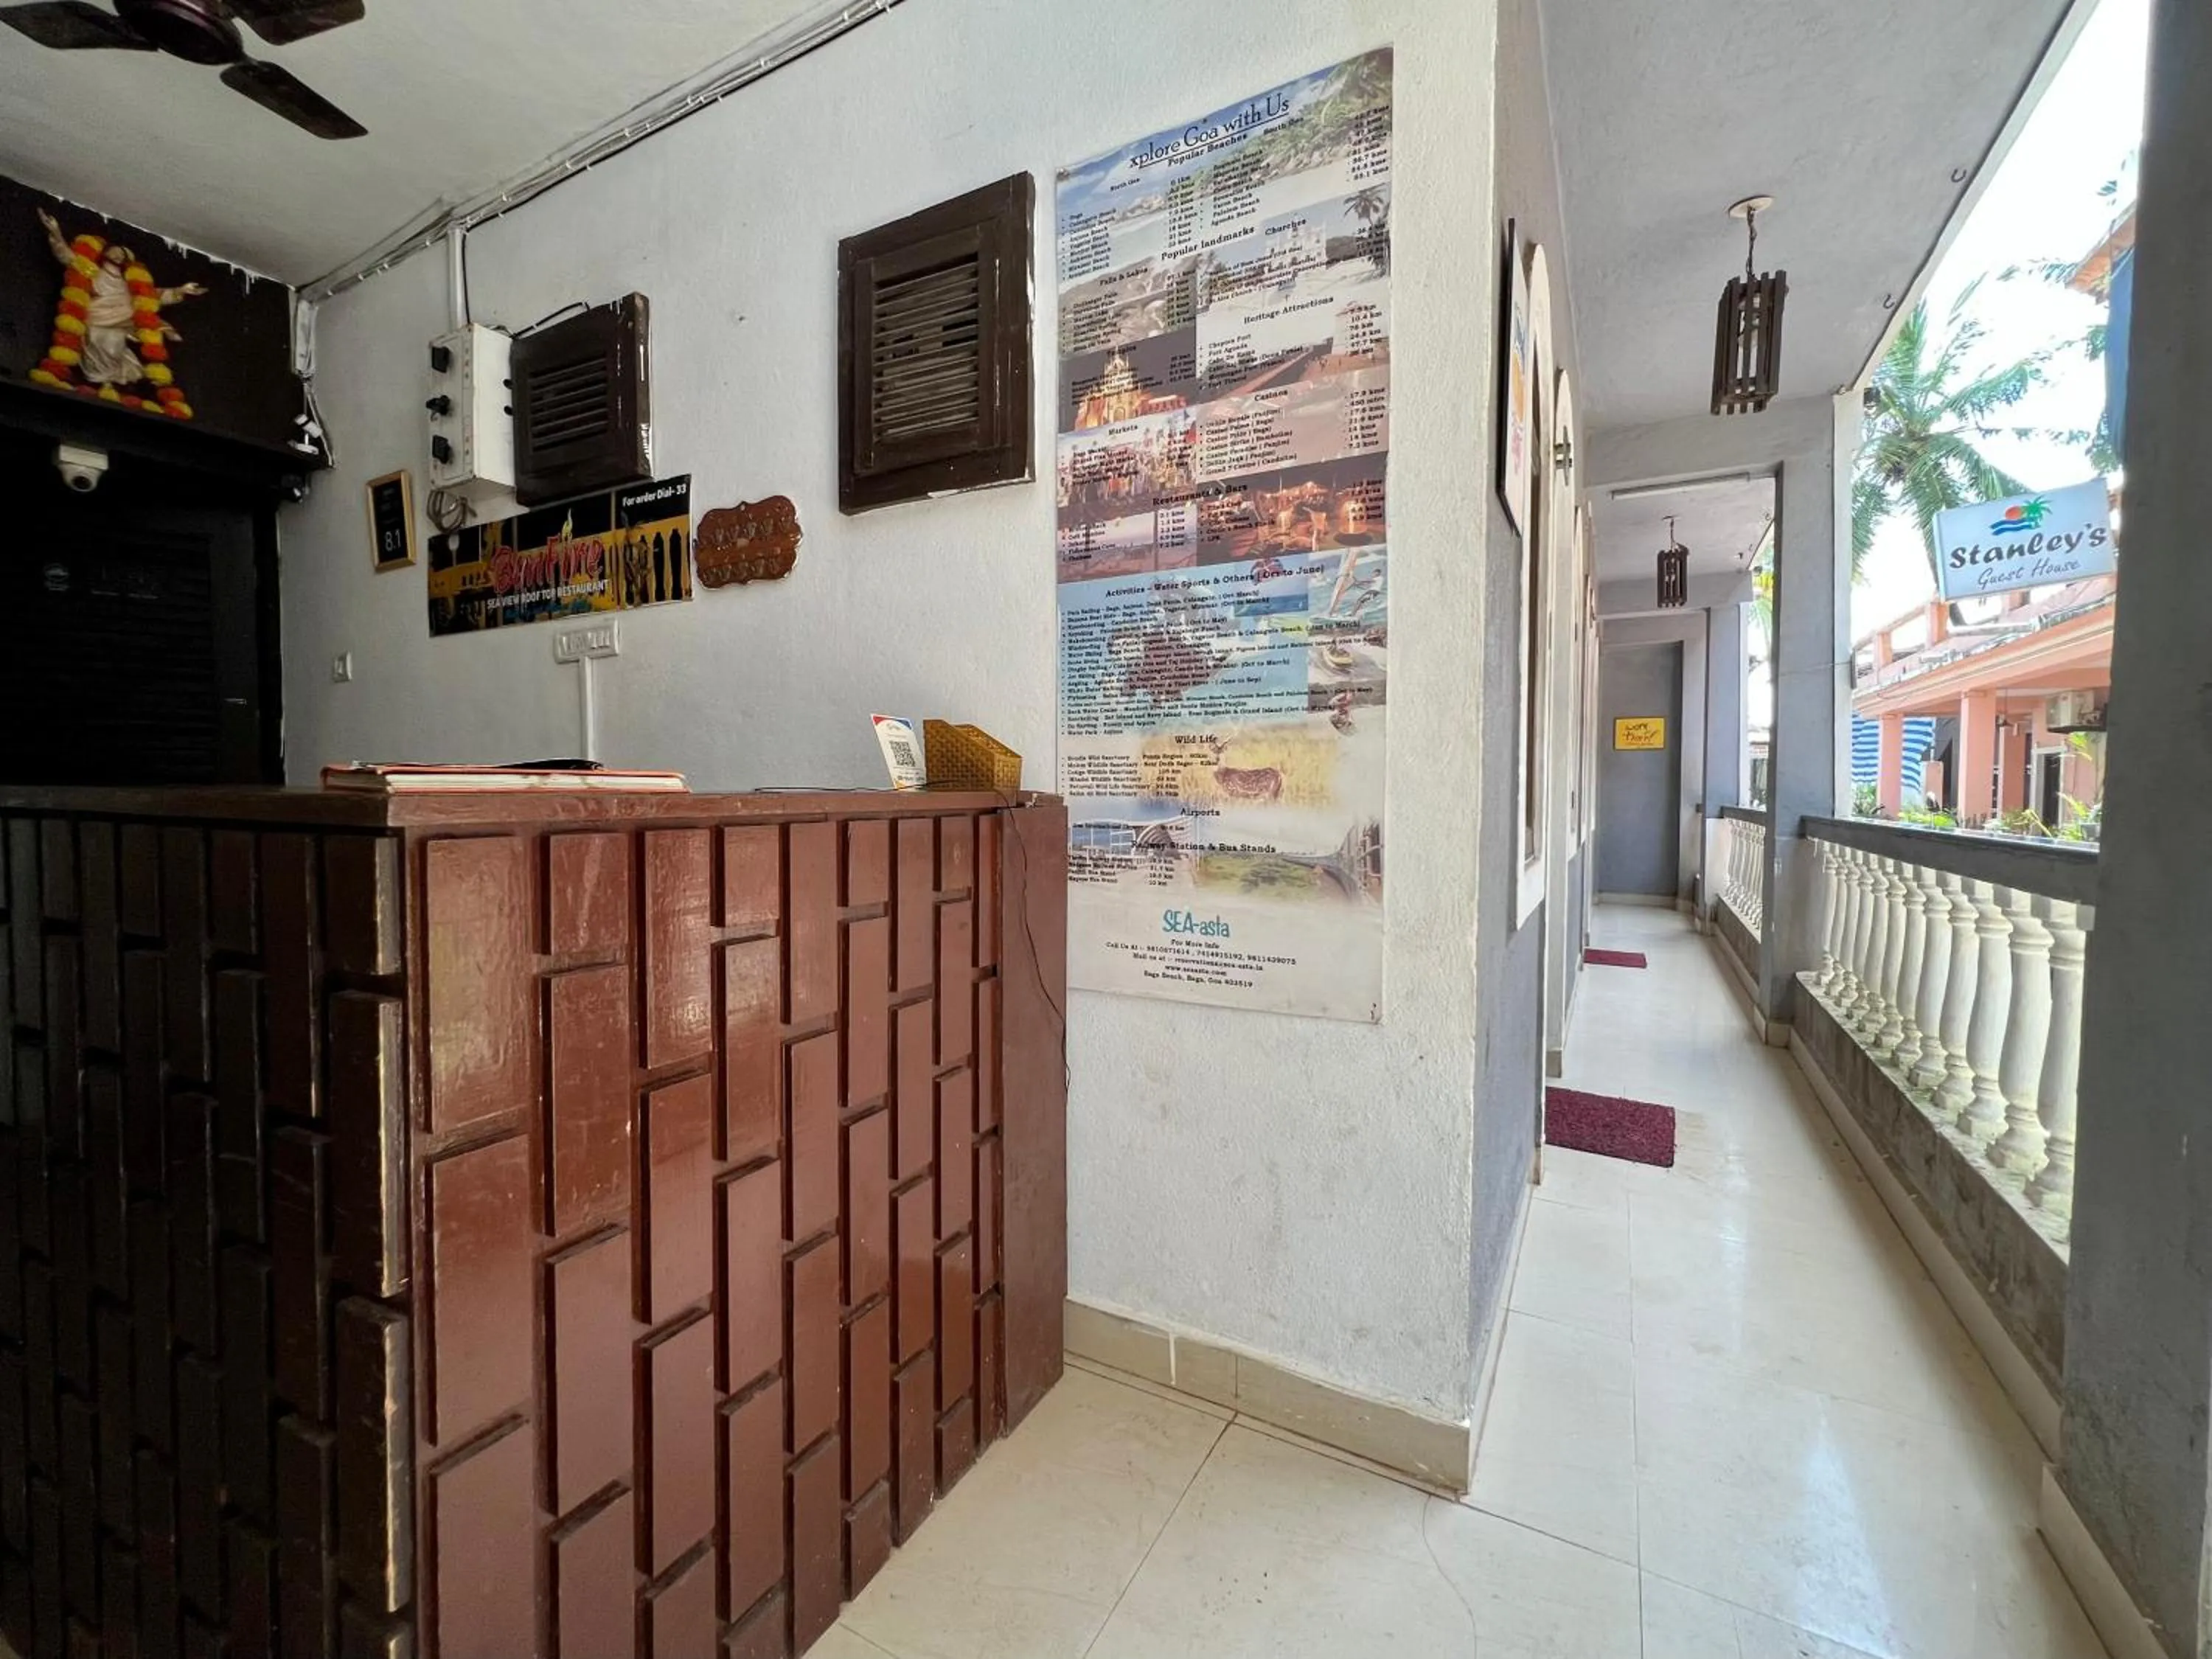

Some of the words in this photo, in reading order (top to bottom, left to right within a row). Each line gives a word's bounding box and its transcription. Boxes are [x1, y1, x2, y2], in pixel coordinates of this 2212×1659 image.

[1183, 126, 1218, 147] Goa
[1223, 103, 1262, 134] with
[1267, 93, 1289, 116] Us
[1168, 150, 1204, 167] Popular
[1208, 133, 1248, 153] Beaches
[1265, 219, 1307, 235] Churches
[1161, 245, 1197, 260] Popular
[1201, 226, 1254, 248] landmarks
[1244, 310, 1279, 324] Heritage
[1282, 296, 1334, 314] Attractions
[1254, 389, 1288, 402] Casinos
[1109, 424, 1138, 436] Markets
[622, 495, 634, 507] For
[676, 483, 686, 495] 33
[1152, 490, 1210, 506] Restaurants
[1225, 485, 1248, 493] Bars
[1950, 523, 2107, 569] Stanley's
[1106, 586, 1145, 597] Activities
[1154, 582, 1179, 591] Water
[1181, 579, 1210, 589] Sports
[1222, 574, 1253, 583] Others
[1978, 567, 2024, 591] Guest
[2031, 557, 2081, 578] House
[487, 594, 502, 609] SEA
[502, 594, 520, 607] VIEW
[557, 579, 609, 598] RESTAURANT
[1175, 735, 1196, 744] Wild
[1200, 735, 1219, 744] Life
[1180, 808, 1220, 817] Airports
[1171, 842, 1206, 851] Station
[1219, 843, 1238, 852] Bus
[1239, 844, 1276, 853] Stands
